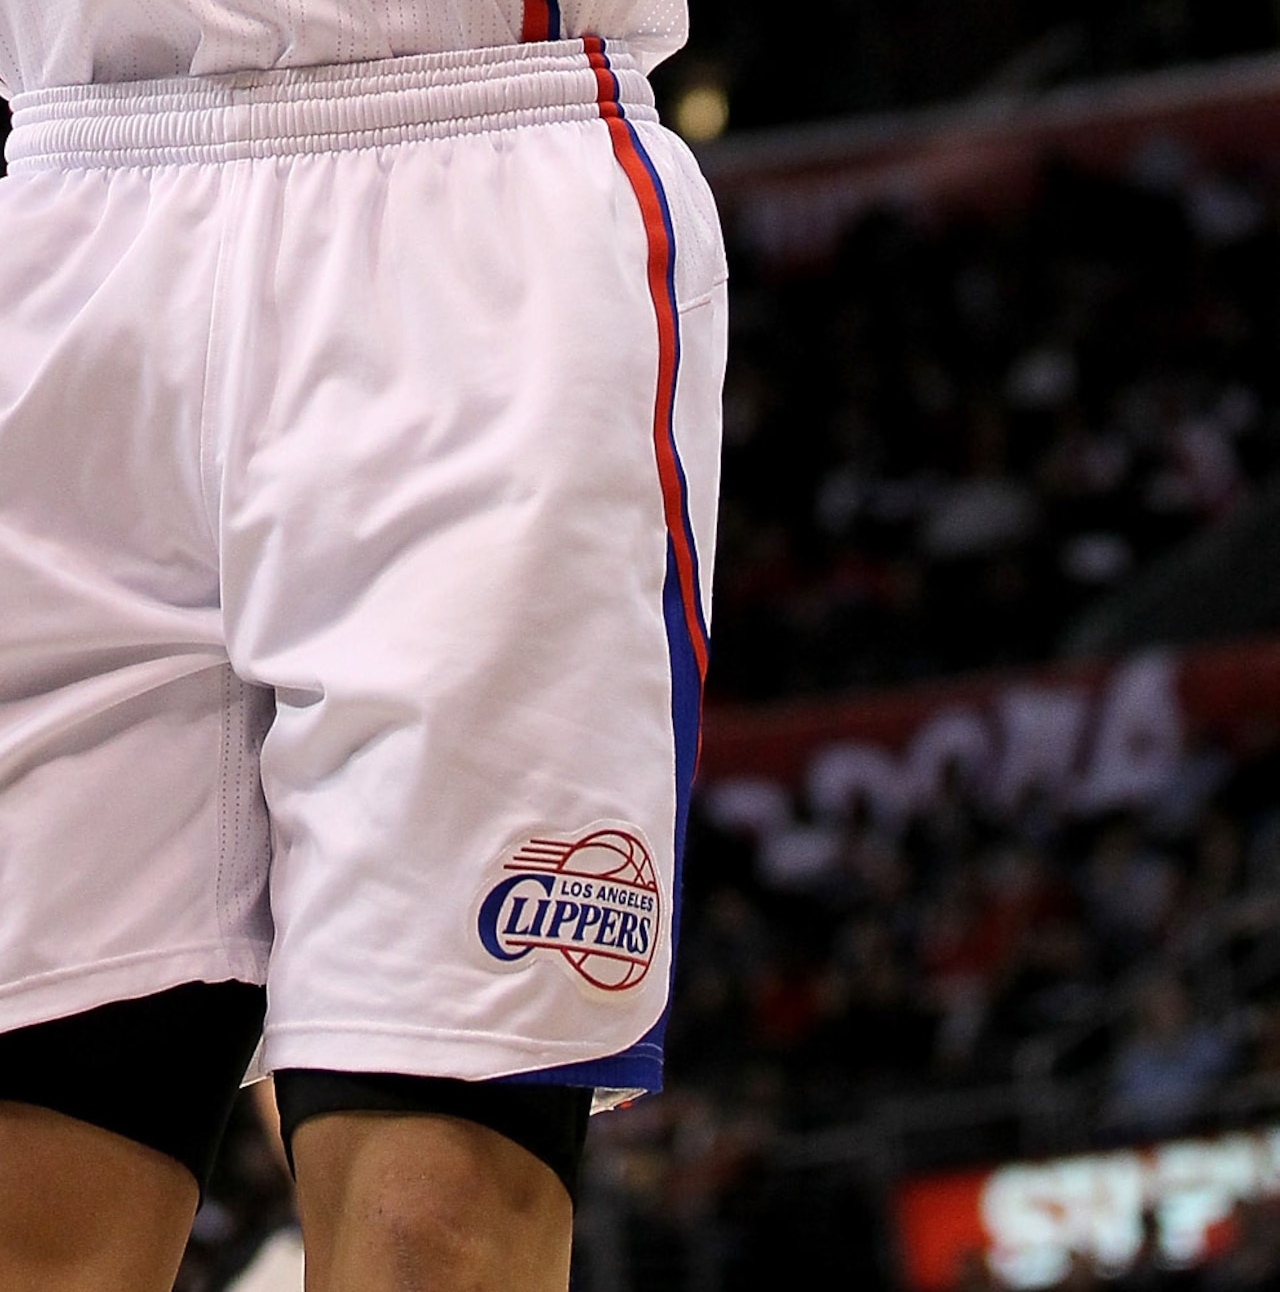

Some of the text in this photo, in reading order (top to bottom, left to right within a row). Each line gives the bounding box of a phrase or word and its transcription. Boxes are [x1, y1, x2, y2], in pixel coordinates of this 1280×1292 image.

[477, 873, 651, 961] CLIPPERS
[561, 880, 654, 913] LOS ANGELES
